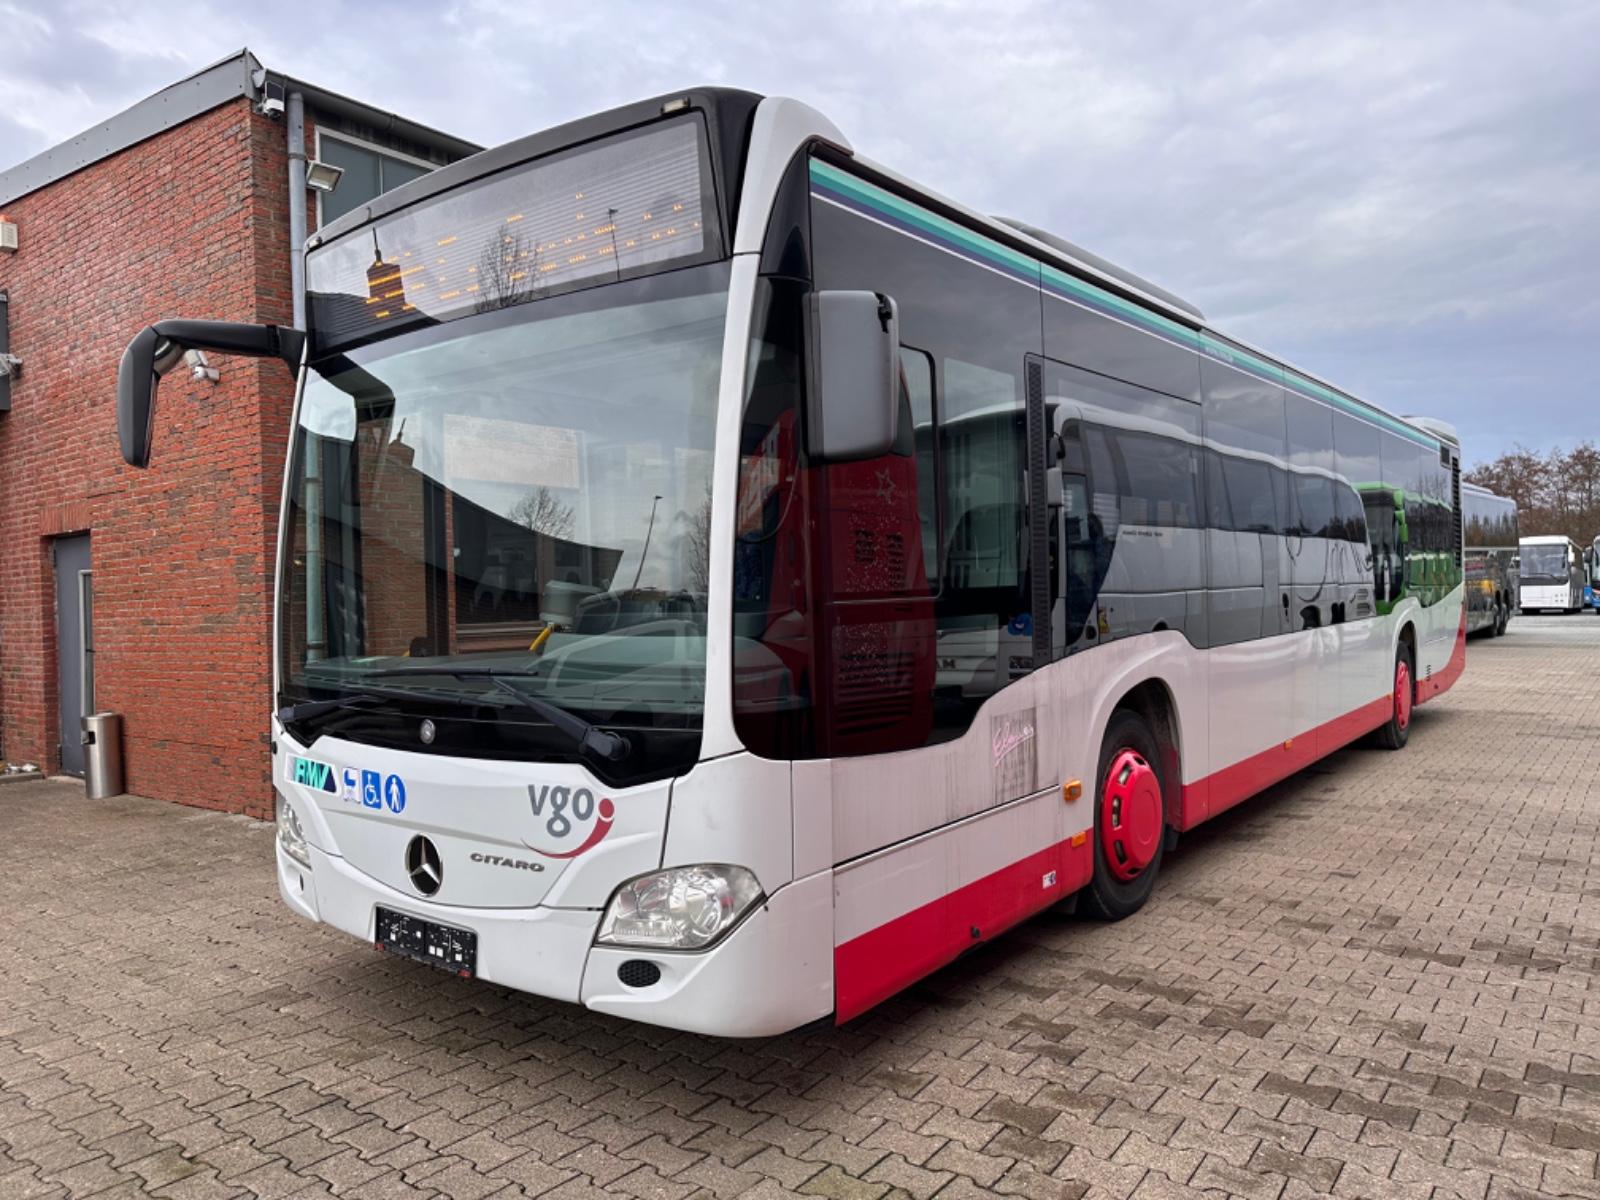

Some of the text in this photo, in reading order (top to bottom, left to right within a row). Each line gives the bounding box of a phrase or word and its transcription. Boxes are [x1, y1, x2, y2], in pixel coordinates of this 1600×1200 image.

[294, 757, 332, 792] RMV
[528, 785, 595, 837] vgo
[470, 853, 545, 872] CITARO
